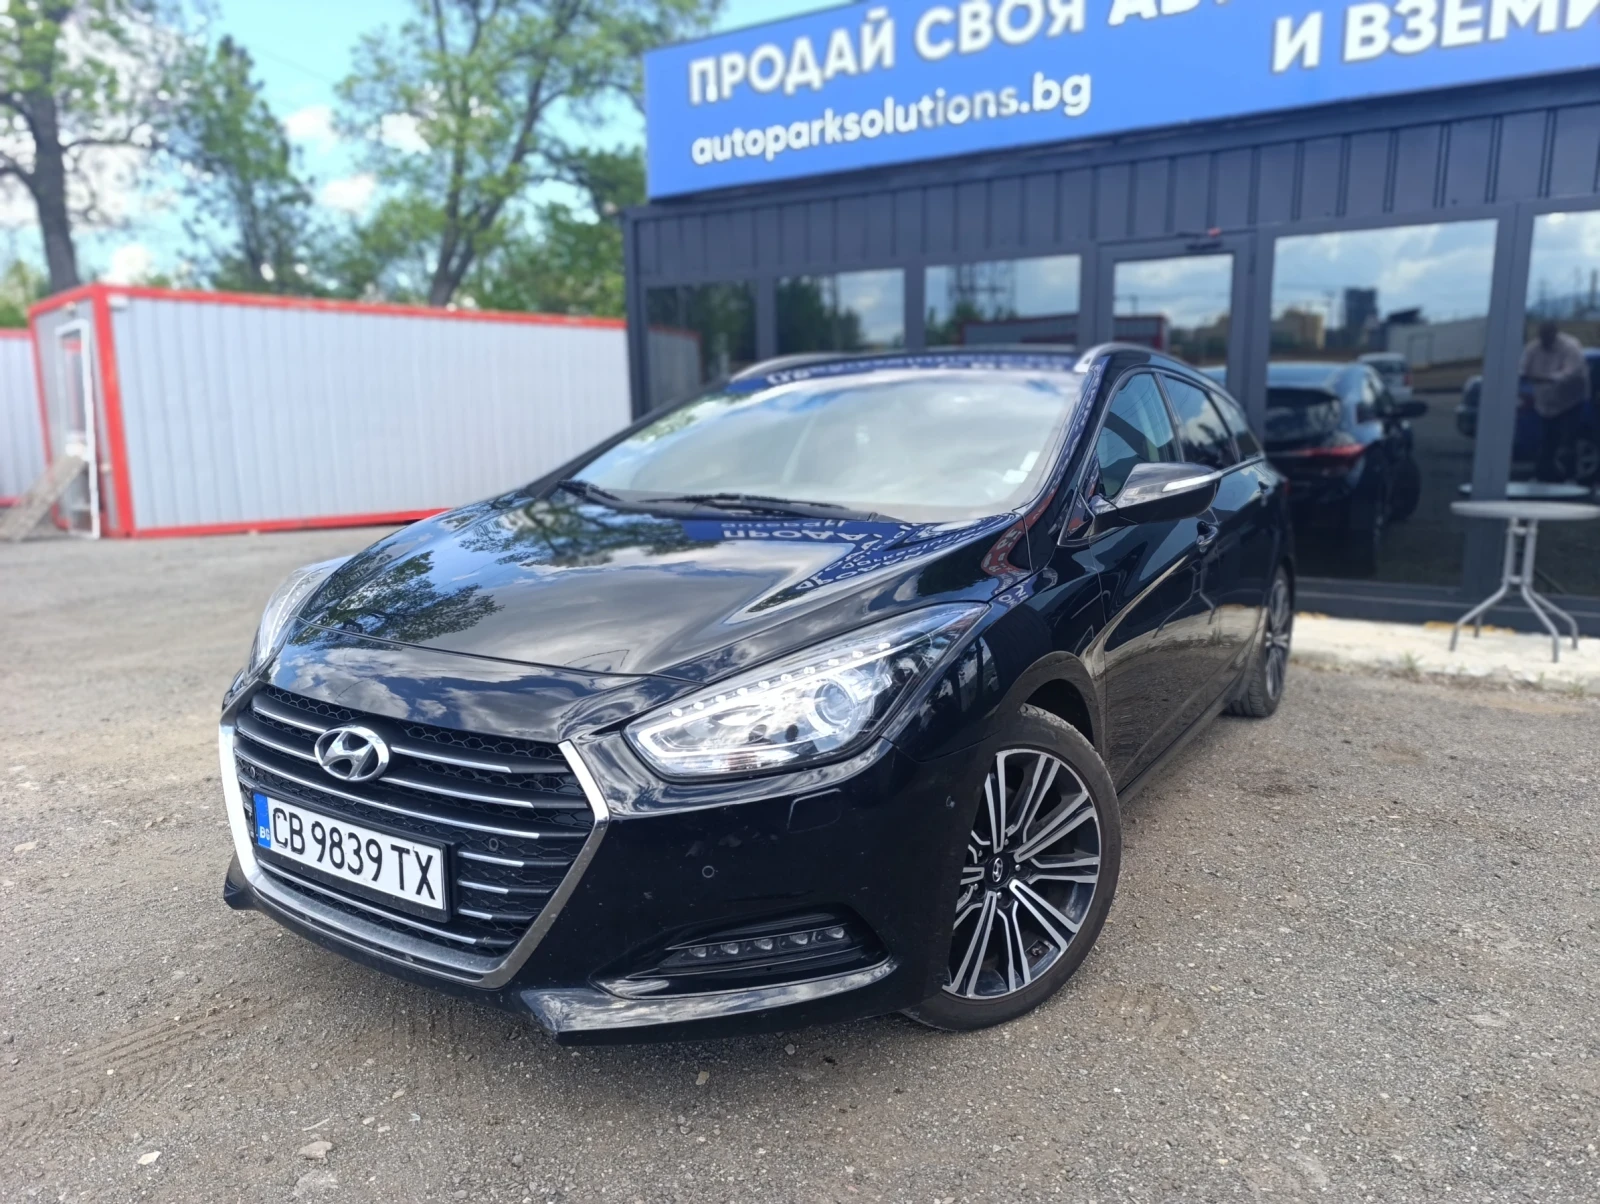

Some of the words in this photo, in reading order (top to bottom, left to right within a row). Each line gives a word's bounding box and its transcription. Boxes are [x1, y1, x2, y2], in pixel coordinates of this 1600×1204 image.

[688, 7, 896, 105] ПРОДАЙ
[914, 0, 1086, 60] СВОЯ
[1272, 11, 1323, 73] И
[691, 71, 1092, 165] autoparksolutions.bg
[259, 825, 271, 841] BG
[272, 807, 306, 855] CB
[311, 820, 383, 882] 9839
[390, 843, 436, 901] TX
